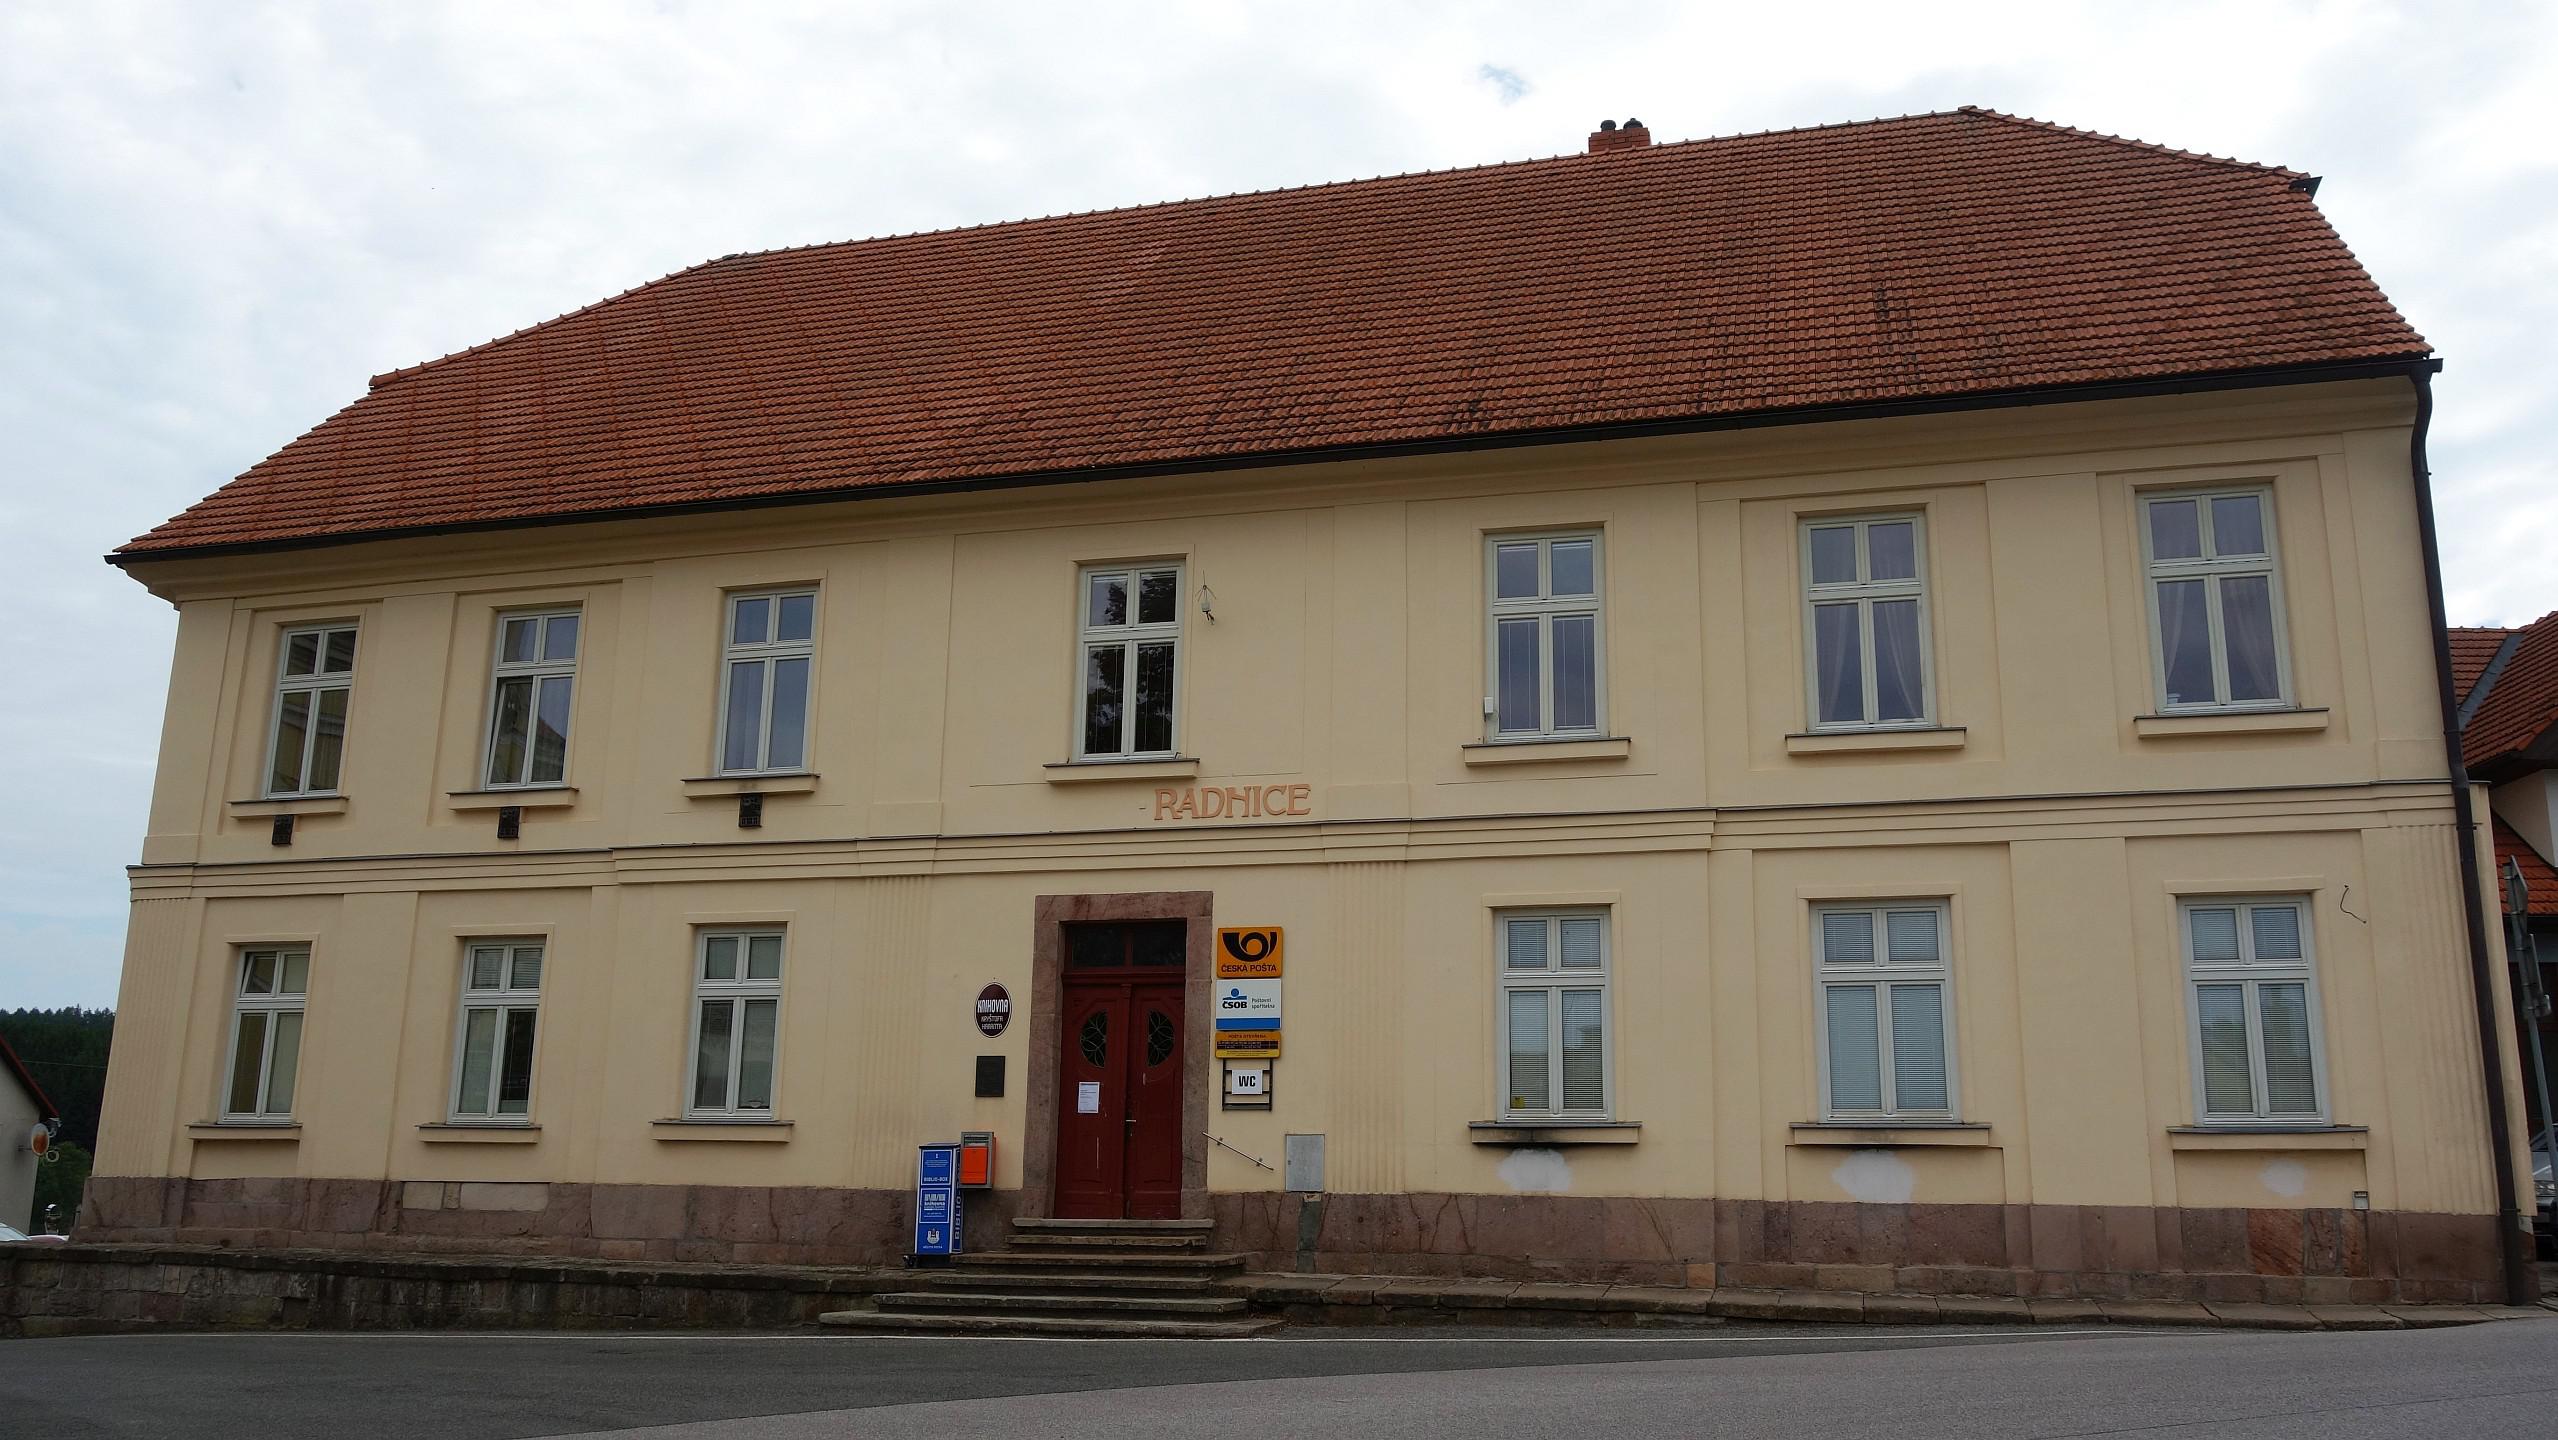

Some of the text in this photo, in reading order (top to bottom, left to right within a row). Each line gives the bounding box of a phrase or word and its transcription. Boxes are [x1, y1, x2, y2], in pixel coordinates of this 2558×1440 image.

[1154, 784, 1311, 820] RADNICE
[1221, 962, 1277, 972] ČESKÁ POŠTA
[977, 999, 1008, 1013] KNIHOVNA
[1222, 1001, 1248, 1009] ČSOB
[1238, 1075, 1256, 1087] WC
